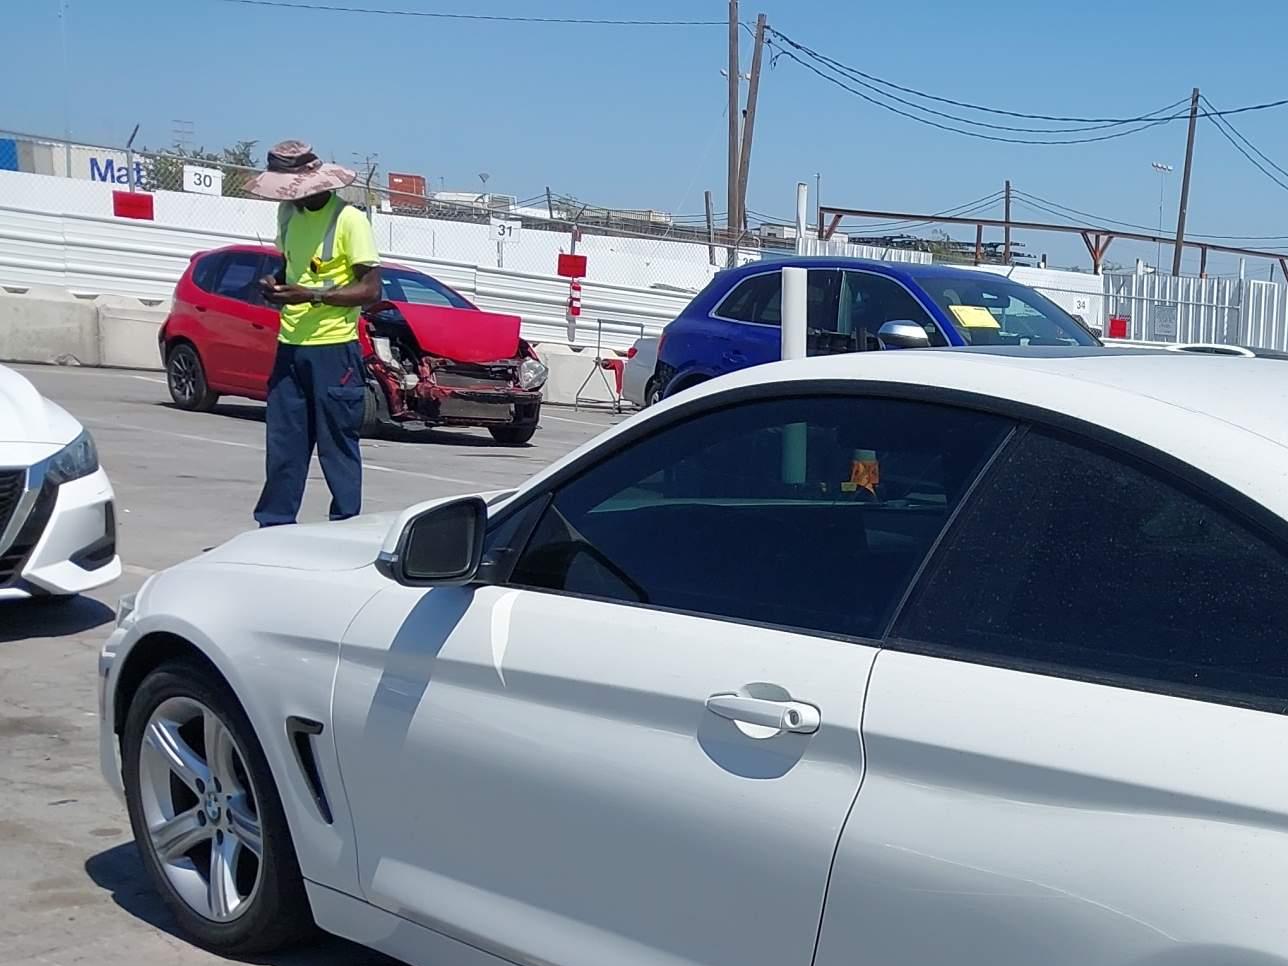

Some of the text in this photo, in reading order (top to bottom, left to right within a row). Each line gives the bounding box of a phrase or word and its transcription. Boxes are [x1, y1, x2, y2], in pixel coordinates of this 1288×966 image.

[193, 172, 213, 189] 30
[498, 224, 513, 238] 31
[1076, 300, 1086, 310] 34
